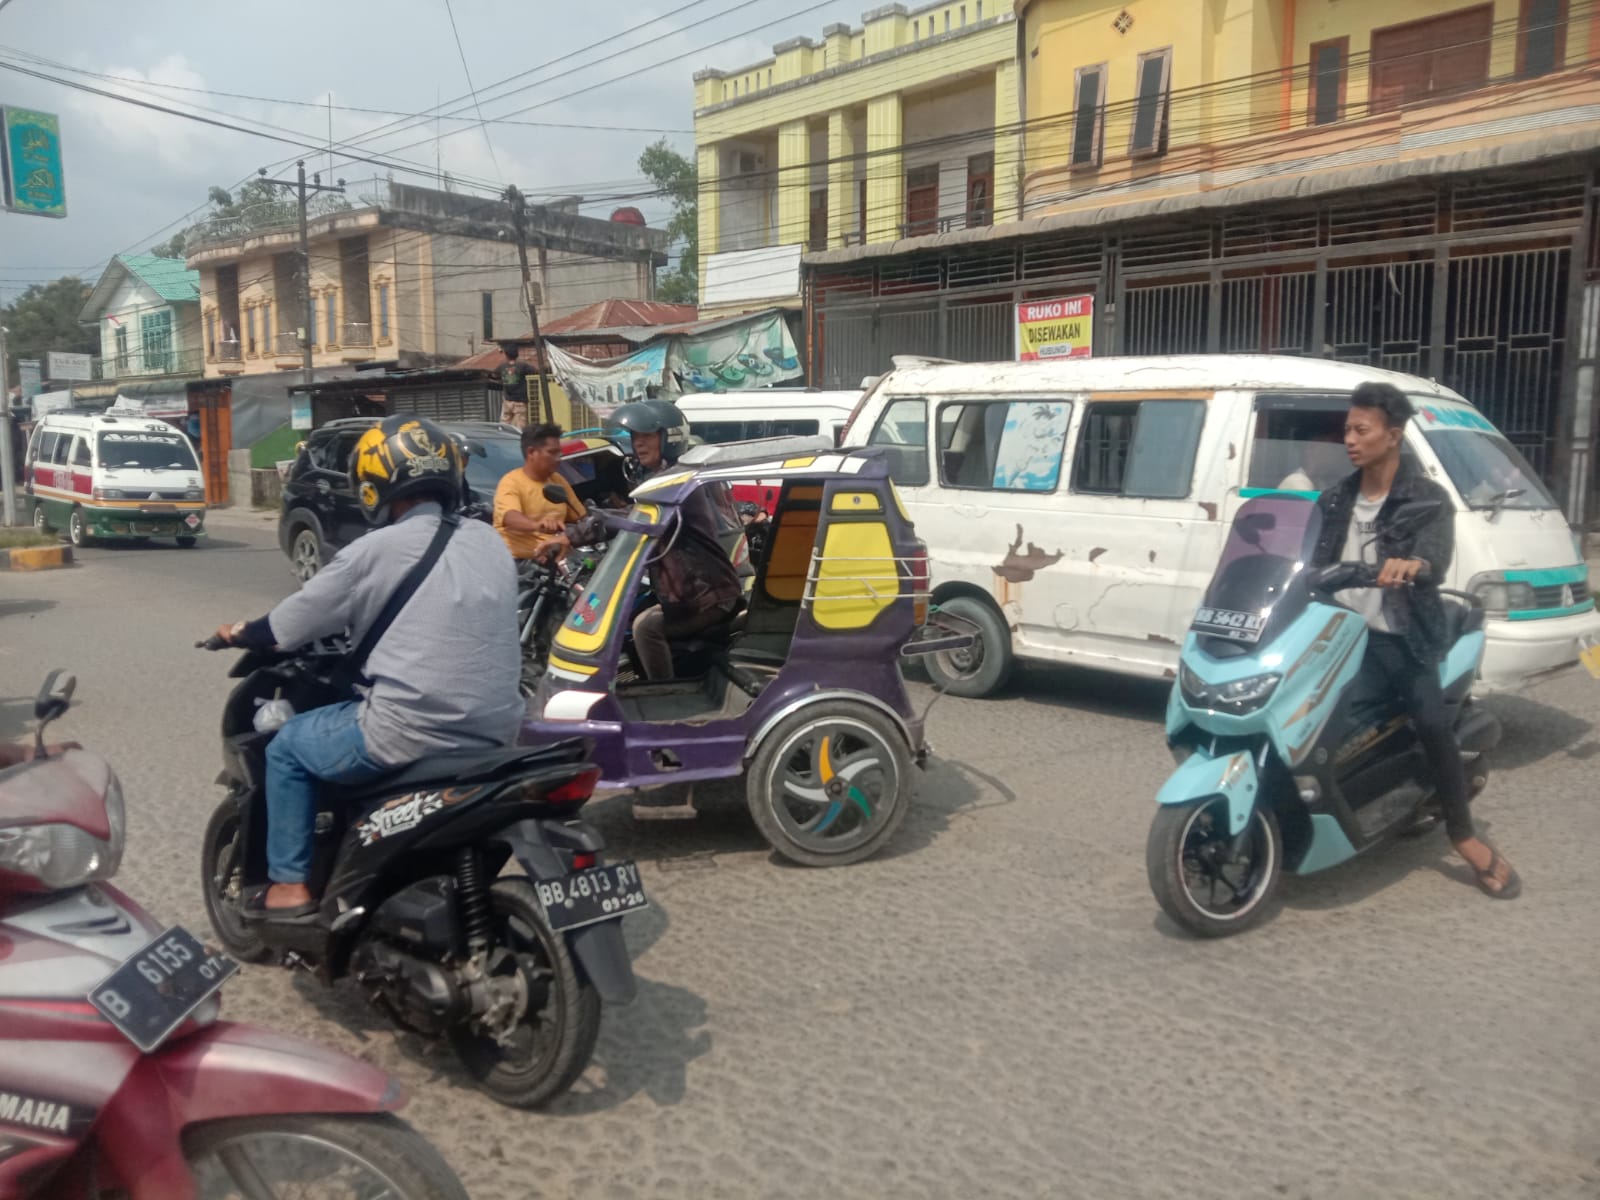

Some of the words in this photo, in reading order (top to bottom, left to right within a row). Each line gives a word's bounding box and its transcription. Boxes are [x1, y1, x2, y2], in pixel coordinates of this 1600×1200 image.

[1027, 304, 1061, 320] RUKO
[1065, 300, 1082, 315] INI
[1028, 322, 1081, 343] DISEWAKAN
[540, 881, 565, 906] BB
[569, 871, 611, 898] 4813
[616, 865, 637, 885] RY
[99, 990, 131, 1019] B
[136, 936, 193, 985] 6155
